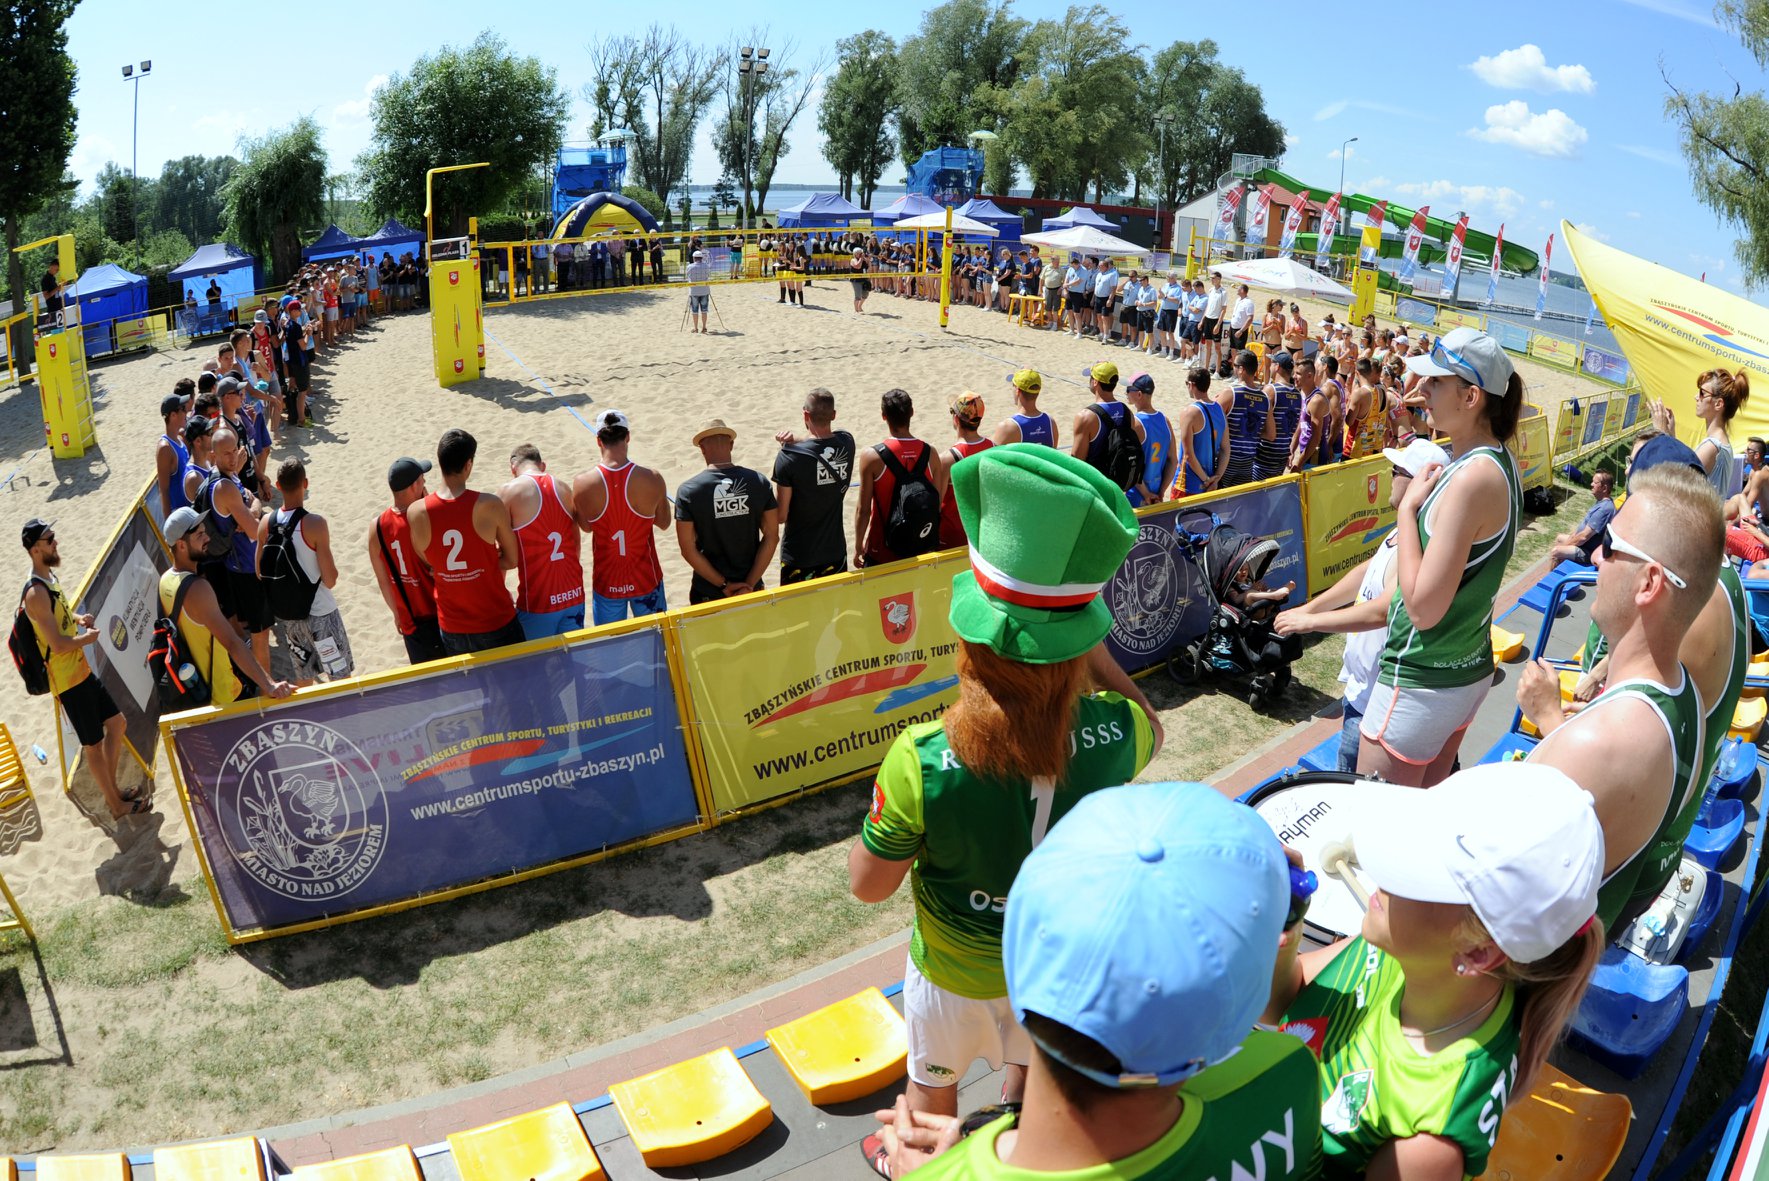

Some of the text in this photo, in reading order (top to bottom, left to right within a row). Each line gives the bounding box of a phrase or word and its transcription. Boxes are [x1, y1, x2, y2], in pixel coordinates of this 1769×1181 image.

[1151, 442, 1161, 463] 2
[714, 498, 749, 513] MGK
[391, 540, 408, 575] 1
[443, 529, 468, 571] 2
[547, 531, 565, 562] 2
[611, 530, 626, 556] 1
[550, 586, 583, 605] BERENT
[825, 657, 880, 681] CENTRUM
[883, 650, 928, 666] SPORTU,
[460, 732, 504, 751] CENTRUM
[507, 728, 545, 741] SPORTU,
[547, 719, 596, 735] TURYSTYKI
[605, 707, 652, 725] REKREACJI
[410, 743, 665, 820] www.centrumsportu-zbaszyn.pl
[1279, 801, 1332, 844] AYMAN
[241, 823, 383, 896] MIASTO NAD JEZIOREM
